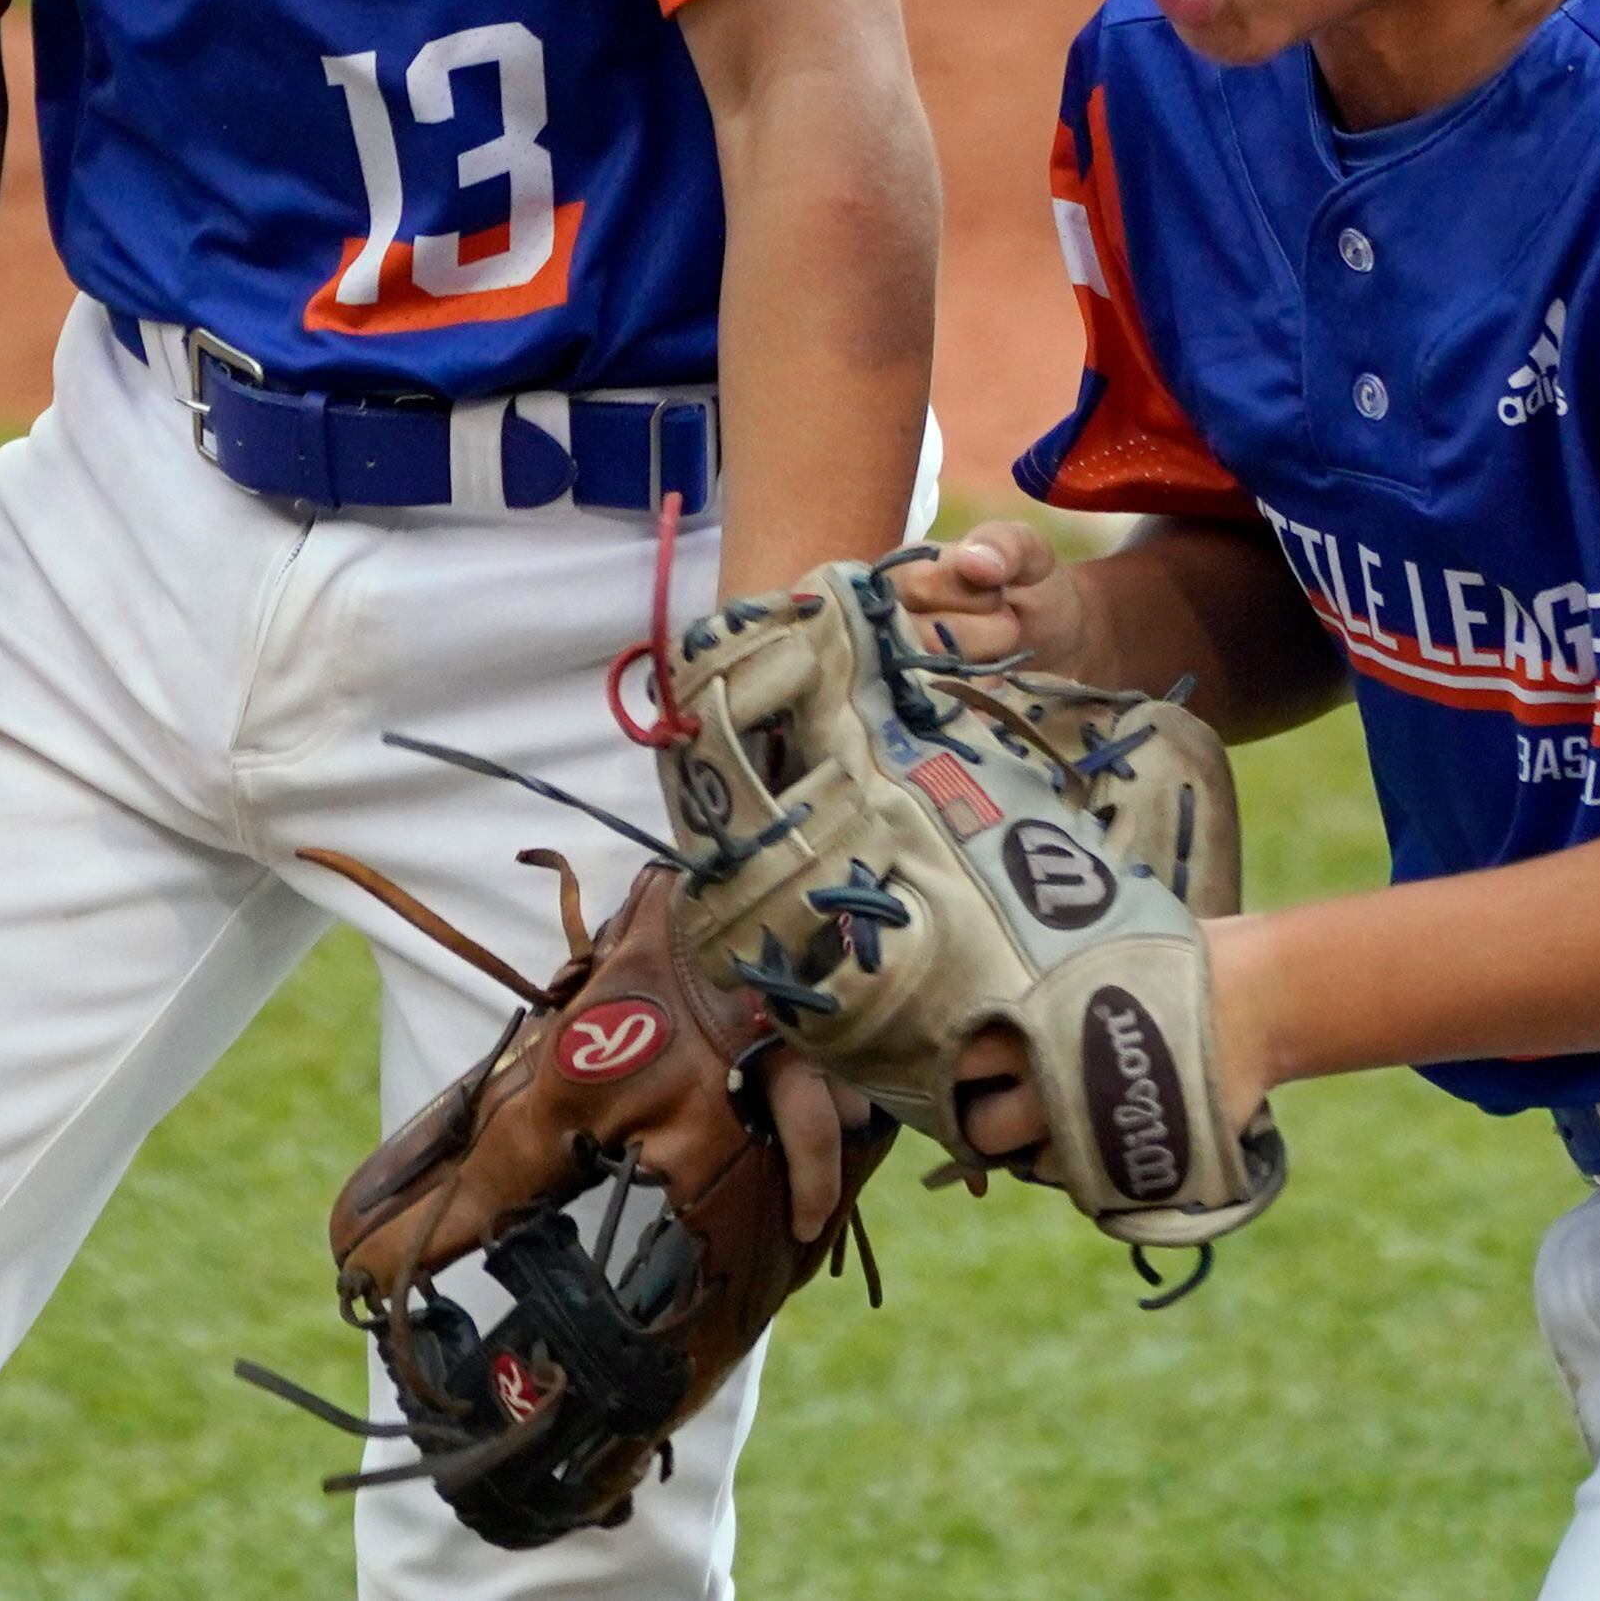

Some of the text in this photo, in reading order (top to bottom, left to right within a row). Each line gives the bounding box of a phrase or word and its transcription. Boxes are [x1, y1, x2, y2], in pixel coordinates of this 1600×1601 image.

[321, 22, 555, 306] 13
[1256, 496, 1398, 651] TTLE
[1092, 1003, 1179, 1196] Wilson
